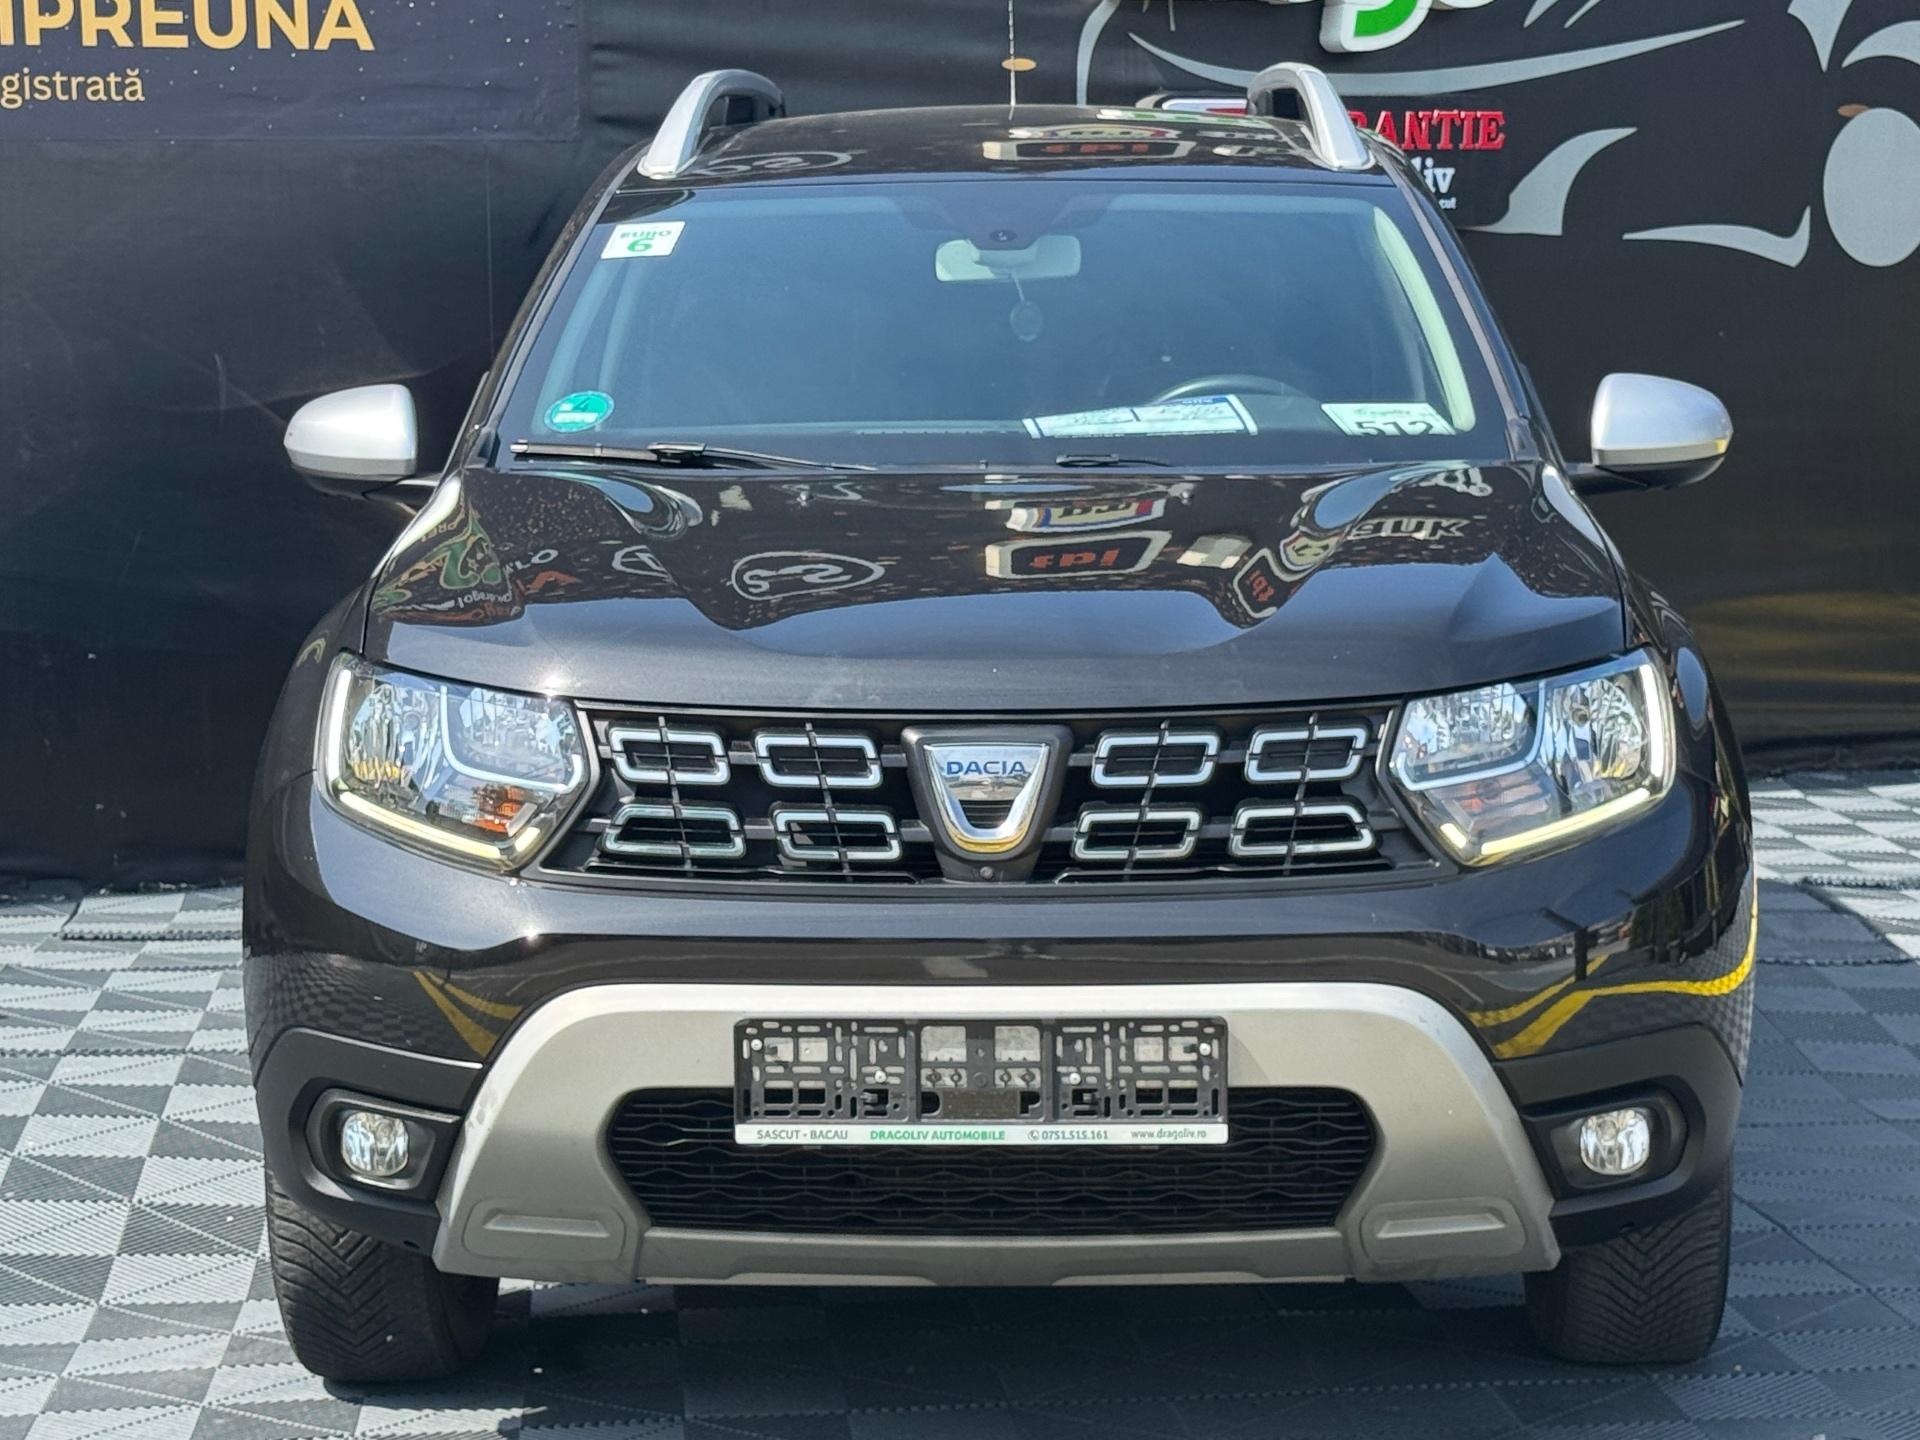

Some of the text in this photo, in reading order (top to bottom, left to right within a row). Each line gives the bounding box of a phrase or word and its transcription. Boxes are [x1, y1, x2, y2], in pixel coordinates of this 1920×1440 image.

[627, 236, 656, 252] 6
[946, 761, 1026, 775] DACIA
[756, 1130, 801, 1141] SASCUT
[869, 1130, 929, 1141] DRAGOLIV
[930, 1131, 1006, 1142] AUTOMOBILE
[1130, 1127, 1208, 1141] www.dragoliv.ro
